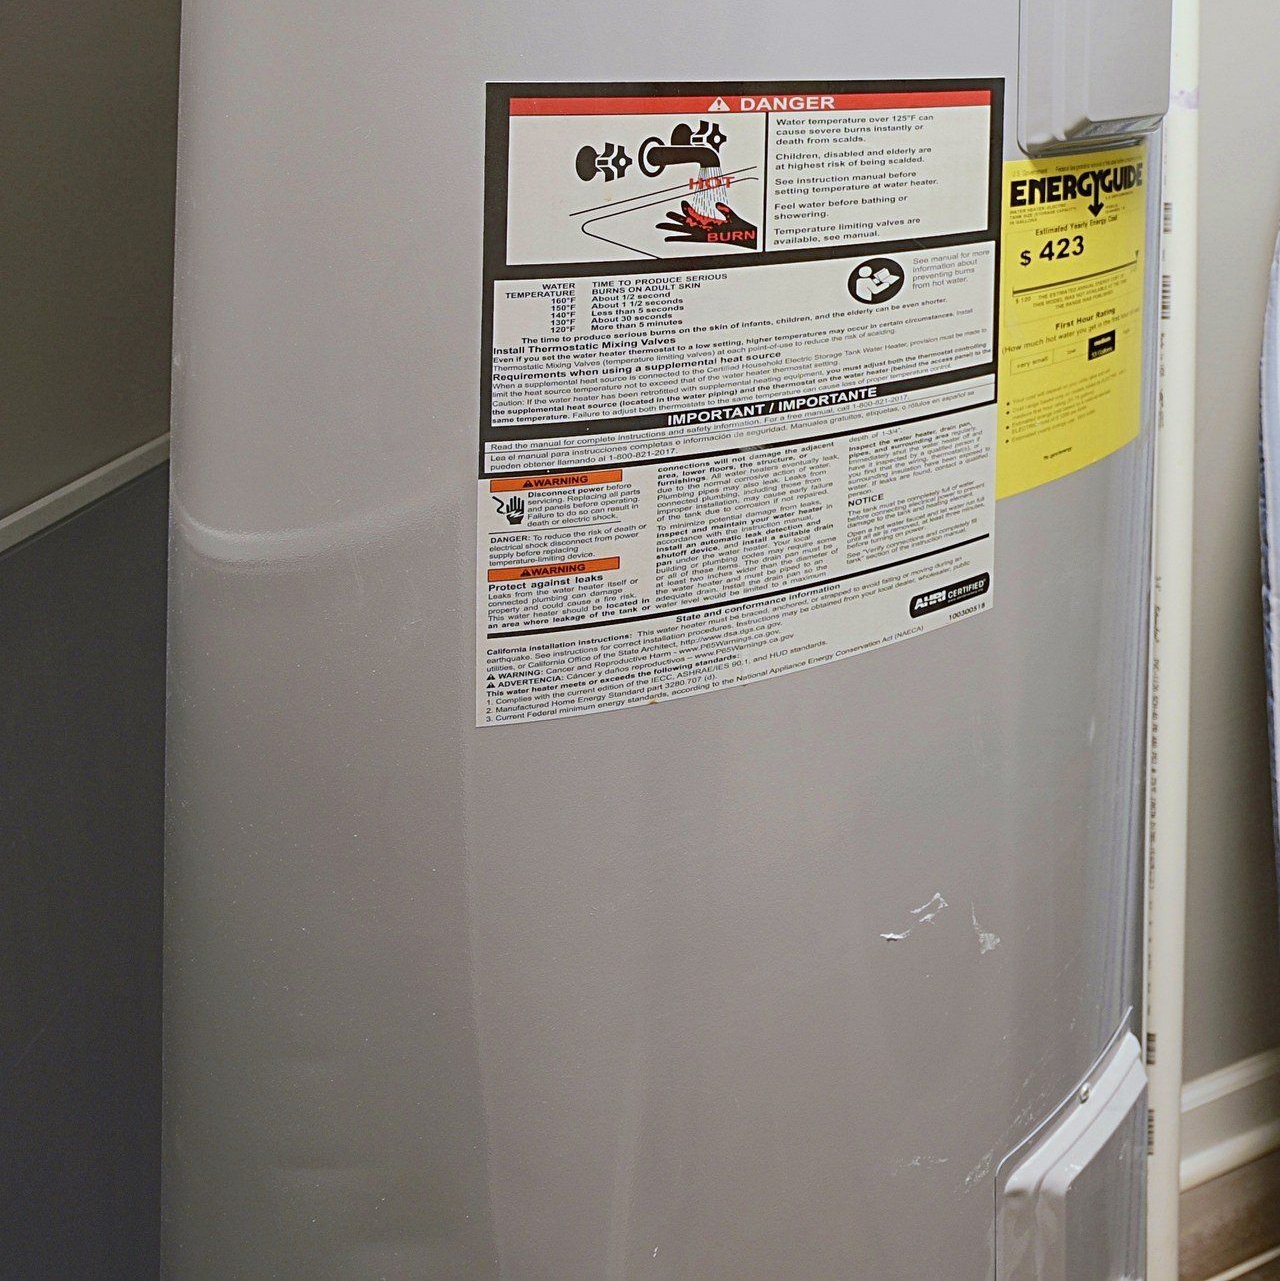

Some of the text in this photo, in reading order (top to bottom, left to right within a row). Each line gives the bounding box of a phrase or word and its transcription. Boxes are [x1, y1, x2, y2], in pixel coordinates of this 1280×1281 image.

[740, 96, 835, 111] DANGER
[777, 118, 805, 126] Water
[808, 116, 866, 126] temperature
[893, 114, 915, 122] 125°F
[873, 124, 912, 134] instantly
[776, 152, 820, 162] Children,
[823, 150, 864, 158] disabled
[886, 147, 916, 156] elderly
[787, 161, 825, 171] highest
[860, 158, 886, 167] being
[888, 156, 925, 164] scalded.
[689, 176, 735, 190] HOT
[796, 175, 850, 184] instruction
[852, 172, 886, 181] manual
[888, 170, 917, 178] before
[775, 178, 938, 197] setting temperature at water heater.
[1010, 162, 1142, 209] ENERGYGUIDE
[775, 202, 796, 210] Feel
[798, 200, 825, 209] water
[828, 198, 859, 207] before
[861, 196, 896, 206] bathing
[775, 211, 829, 221] showering.
[775, 225, 836, 237] Temperature
[838, 221, 874, 232] limiting
[876, 219, 904, 227] valves
[707, 230, 755, 242] BURN
[774, 235, 820, 246] available,
[843, 230, 880, 240] manual.
[1020, 235, 1085, 266] $ 423
[593, 280, 614, 288] TIME
[635, 276, 681, 285] PRODUCE
[686, 273, 728, 282] SERIOUS
[506, 290, 575, 298] TEMPERATURE
[592, 287, 625, 295] BURNS
[645, 284, 674, 292] ADULT
[678, 282, 701, 290] SKIN
[592, 294, 619, 302] About
[637, 291, 671, 299] second
[592, 301, 619, 309] About
[630, 299, 643, 307] 1/2
[644, 297, 683, 306] seconds
[591, 312, 673, 323] About 30 seconds
[592, 308, 613, 316] Less
[615, 307, 636, 315] than
[646, 305, 684, 313] seconds
[591, 323, 614, 331] More
[616, 321, 636, 329] than
[646, 319, 682, 327] minutes
[1055, 308, 1116, 330] First Hour Rating
[494, 337, 676, 355] Install Thermostatic Mixing Valves
[493, 369, 566, 382] Requirements
[569, 365, 599, 375] when
[601, 363, 632, 374] using
[644, 356, 717, 370] supplemental
[720, 354, 743, 363] heat
[745, 352, 781, 361] source
[668, 389, 877, 425] IMPORTANT / IMPORTANTE
[534, 476, 588, 487] WARNING
[528, 483, 632, 498] Disconnect power before
[848, 494, 884, 507] NOTICE
[531, 564, 585, 576] WARNING
[489, 574, 603, 591] Protect against leaks
[947, 579, 984, 598] CERTIFIED
[677, 584, 840, 622] State and conformance information
[487, 634, 633, 655] California installation instructions:
